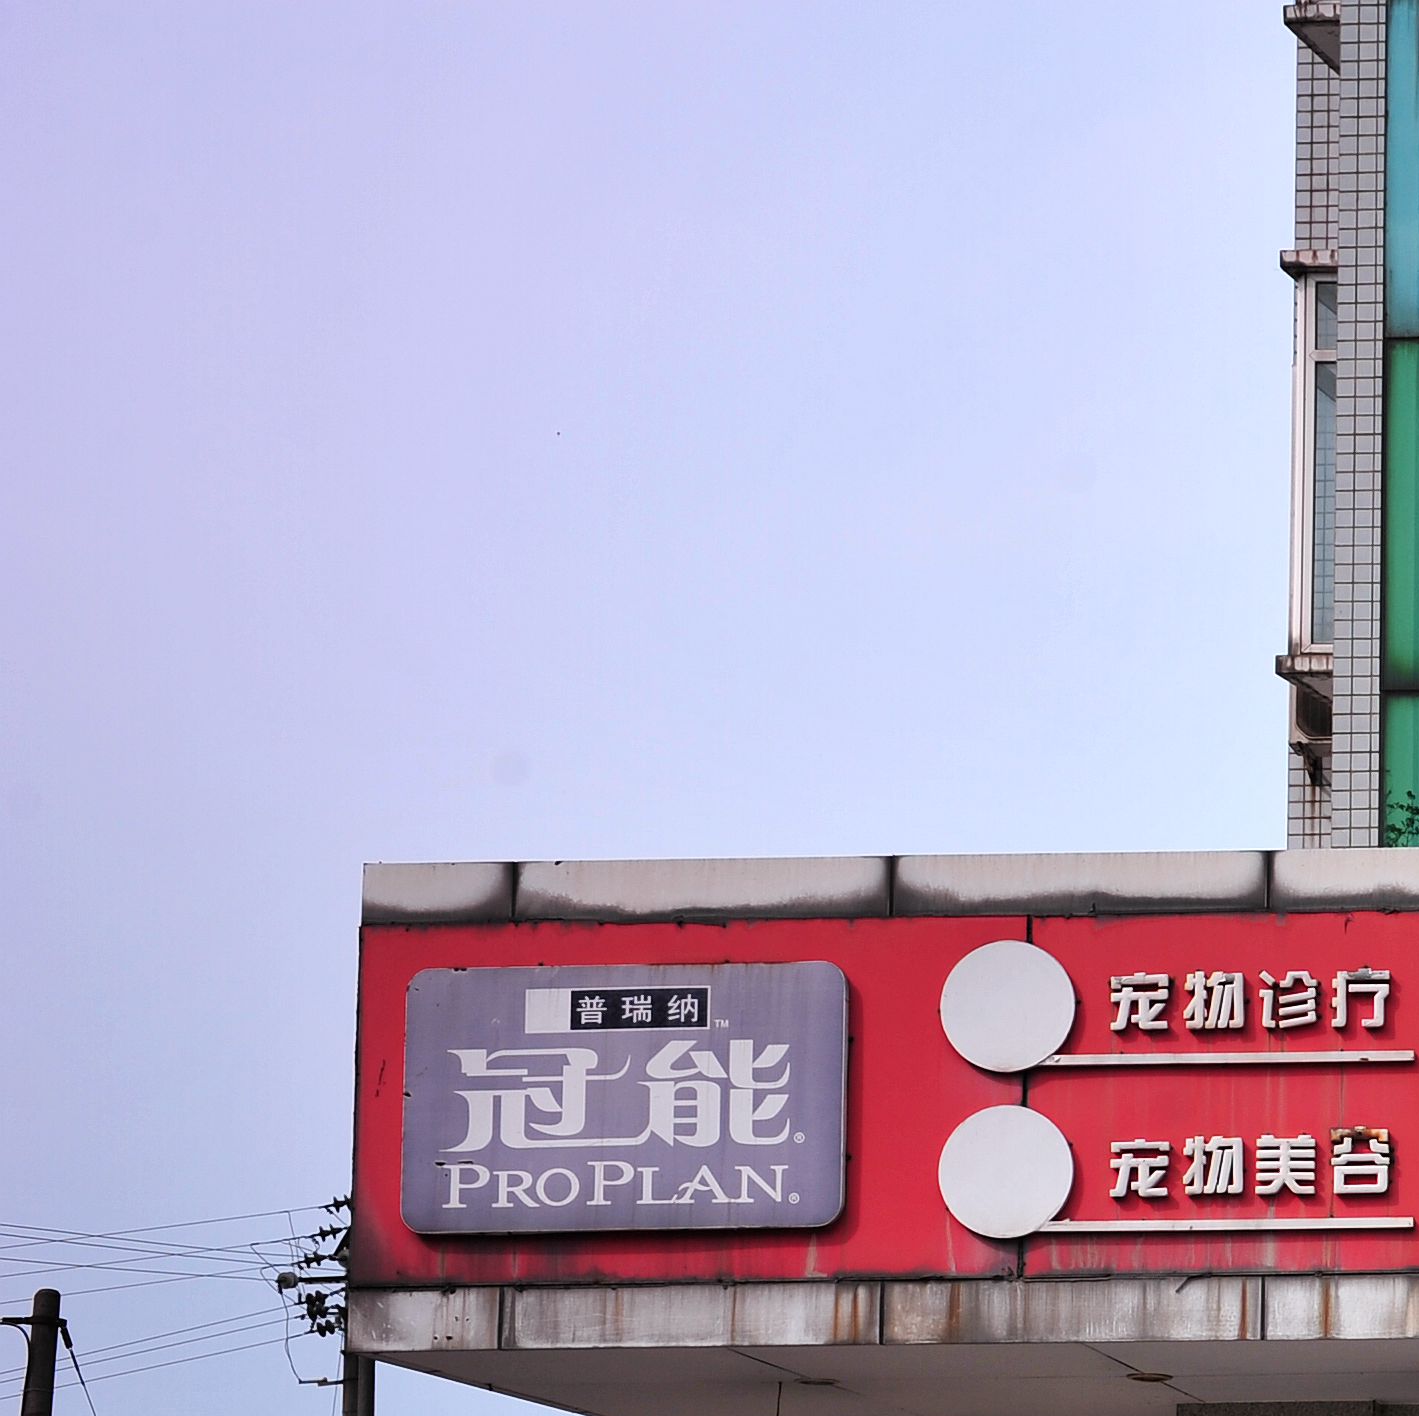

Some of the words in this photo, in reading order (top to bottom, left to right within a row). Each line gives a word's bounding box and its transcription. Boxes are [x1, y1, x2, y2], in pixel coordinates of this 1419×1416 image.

[577, 994, 702, 1027] 普瑞纳
[1109, 967, 1392, 1032] 宠物诊疗
[437, 1038, 794, 1154] 冠能
[1109, 1124, 1391, 1198] 宠物美容
